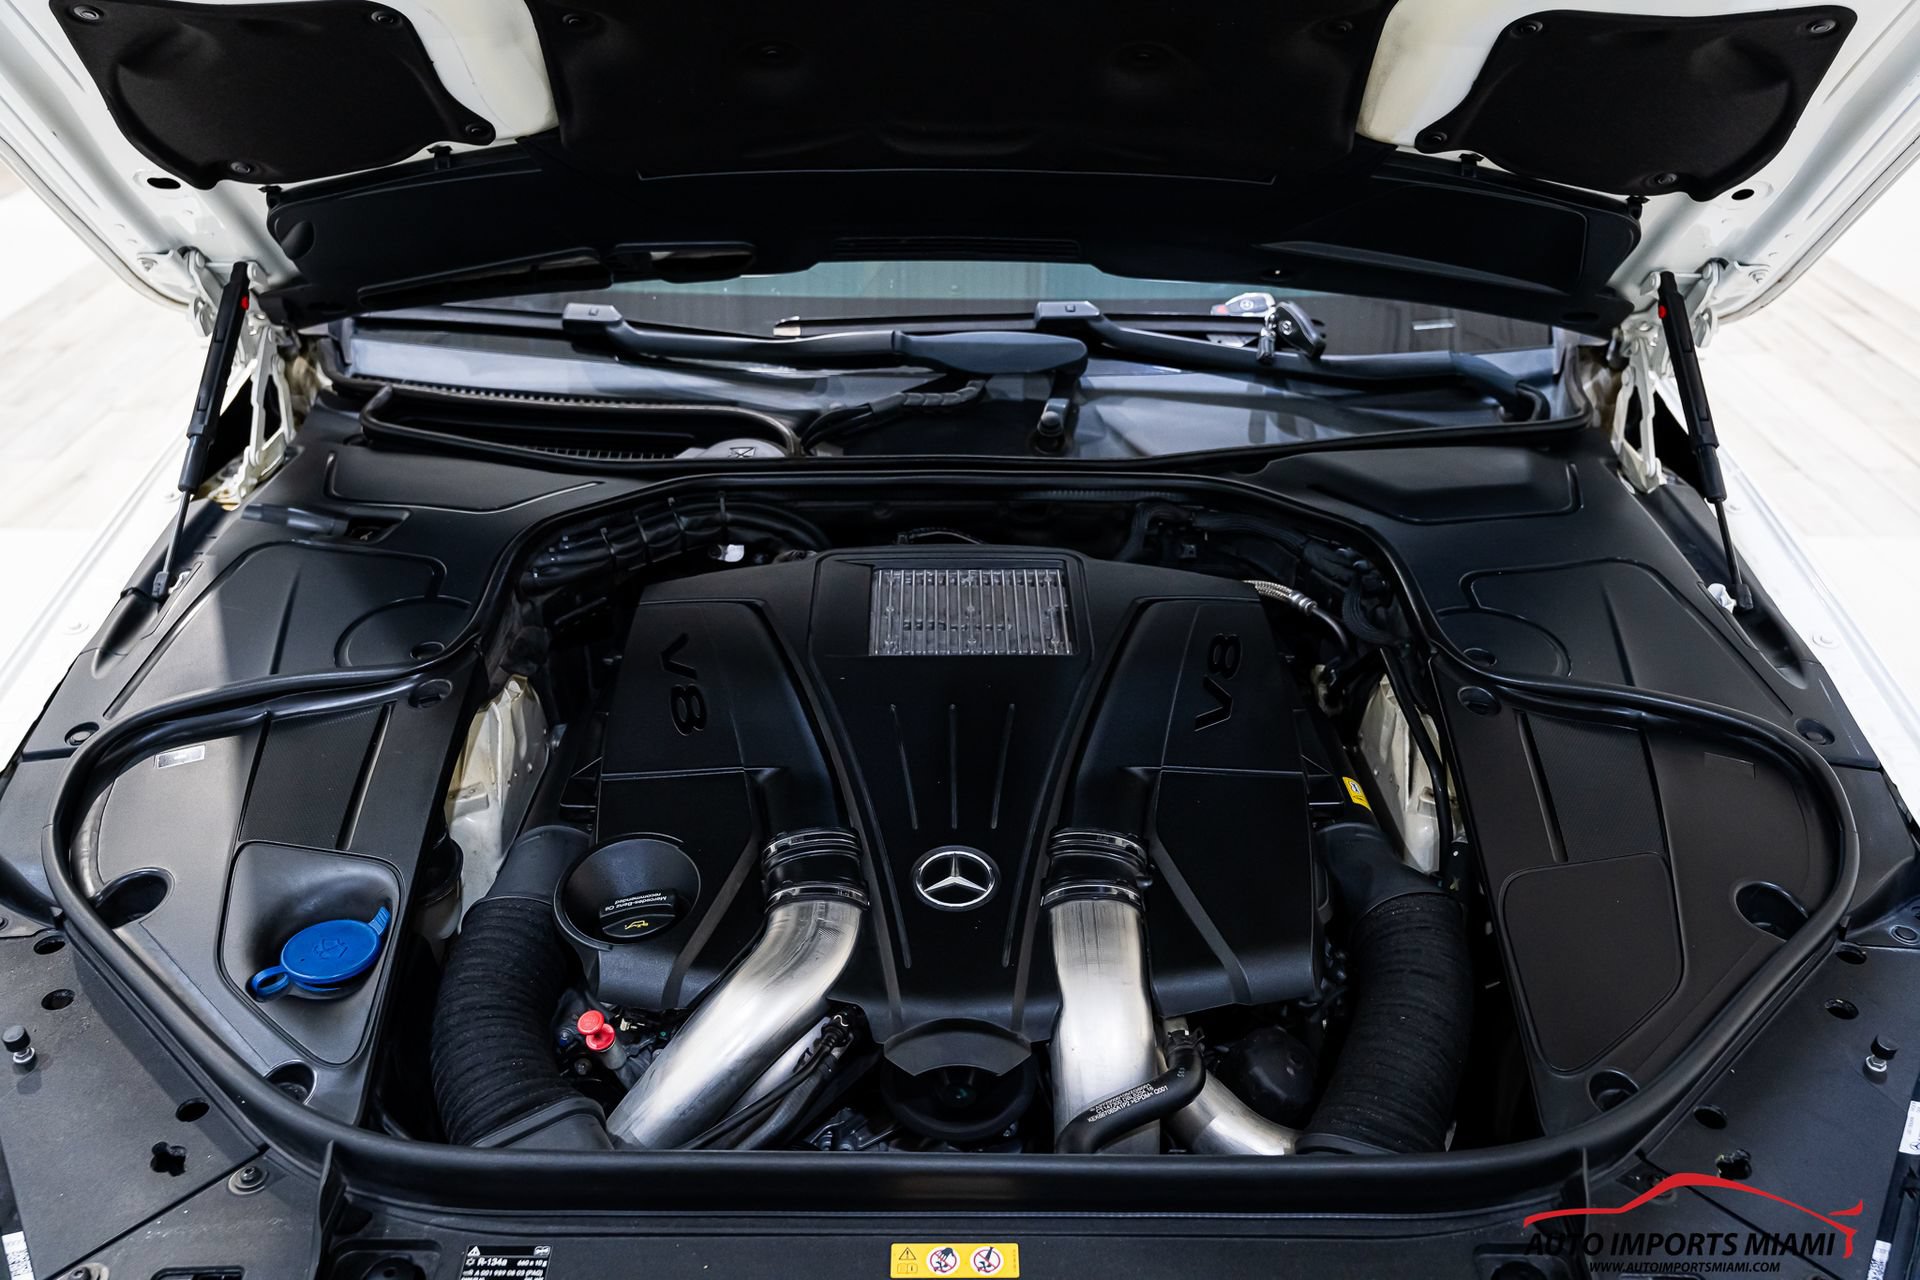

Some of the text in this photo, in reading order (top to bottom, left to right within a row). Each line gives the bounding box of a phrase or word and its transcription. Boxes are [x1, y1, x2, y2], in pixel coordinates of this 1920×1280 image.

[661, 632, 707, 736] V8
[1194, 632, 1243, 732] V8
[614, 892, 662, 904] recommended
[615, 895, 667, 908] Mercedes-Benz
